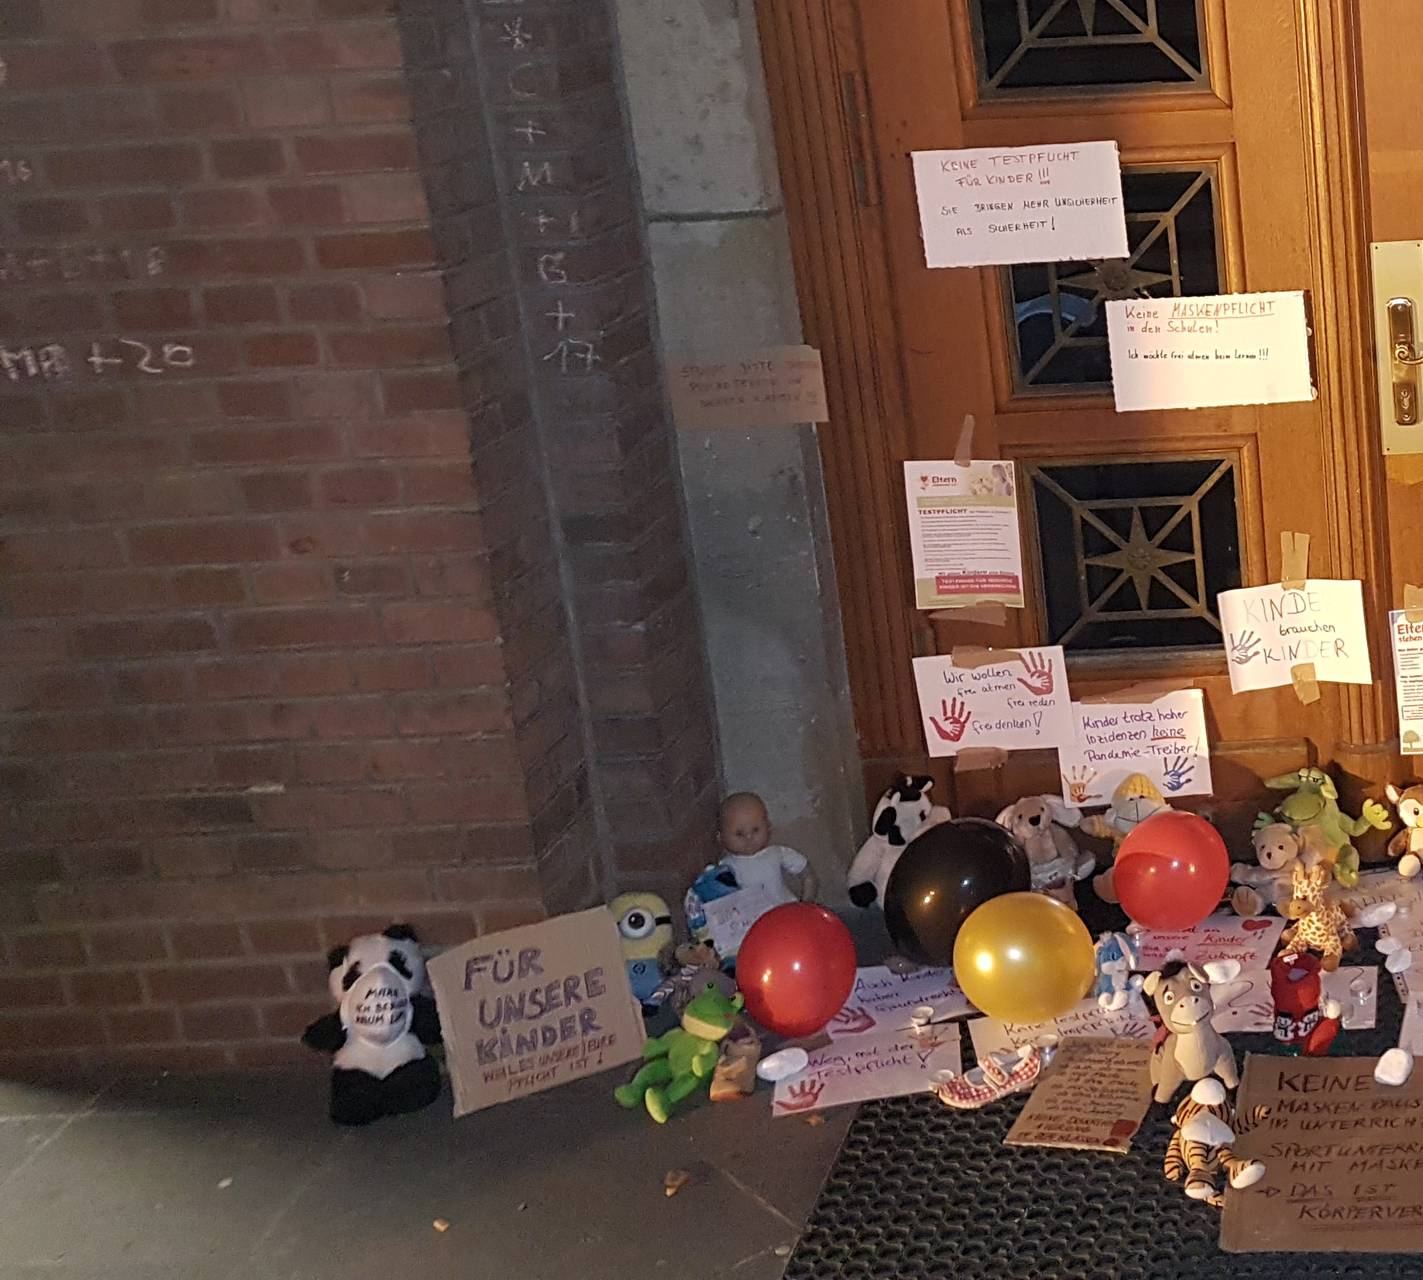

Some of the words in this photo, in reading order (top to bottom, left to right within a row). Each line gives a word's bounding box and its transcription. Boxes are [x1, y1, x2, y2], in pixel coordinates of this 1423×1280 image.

[941, 159, 978, 172] KEINE
[955, 175, 982, 188] FÜR
[986, 172, 1033, 185] KINDER
[941, 205, 959, 216] SIE
[974, 203, 1014, 213] BRINGEN
[1023, 199, 1049, 210] MEHR
[956, 227, 973, 236] ALS
[1125, 306, 1159, 319] Keine
[1171, 301, 1275, 318] MASKENPFLICHT
[1141, 321, 1161, 333] den
[1128, 350, 1139, 359] Ich
[1171, 350, 1184, 359] frei
[1279, 620, 1335, 637] brauchen
[1263, 637, 1349, 664] KINDER
[943, 670, 964, 684] Wir
[971, 668, 1012, 681] wollen
[982, 683, 1016, 692] atmen
[1083, 715, 1118, 730] Kinder
[1122, 710, 1155, 723] trotz
[1158, 709, 1188, 722] hoher
[1153, 725, 1186, 741] keine
[464, 948, 544, 991] FÜR
[479, 966, 606, 1030] UNSERE
[475, 1006, 604, 1066] KINDER
[1278, 1071, 1371, 1092] KEINE
[1290, 1160, 1332, 1173] MIT
[1290, 1182, 1335, 1198] DAS
[1353, 1183, 1397, 1197] IST
